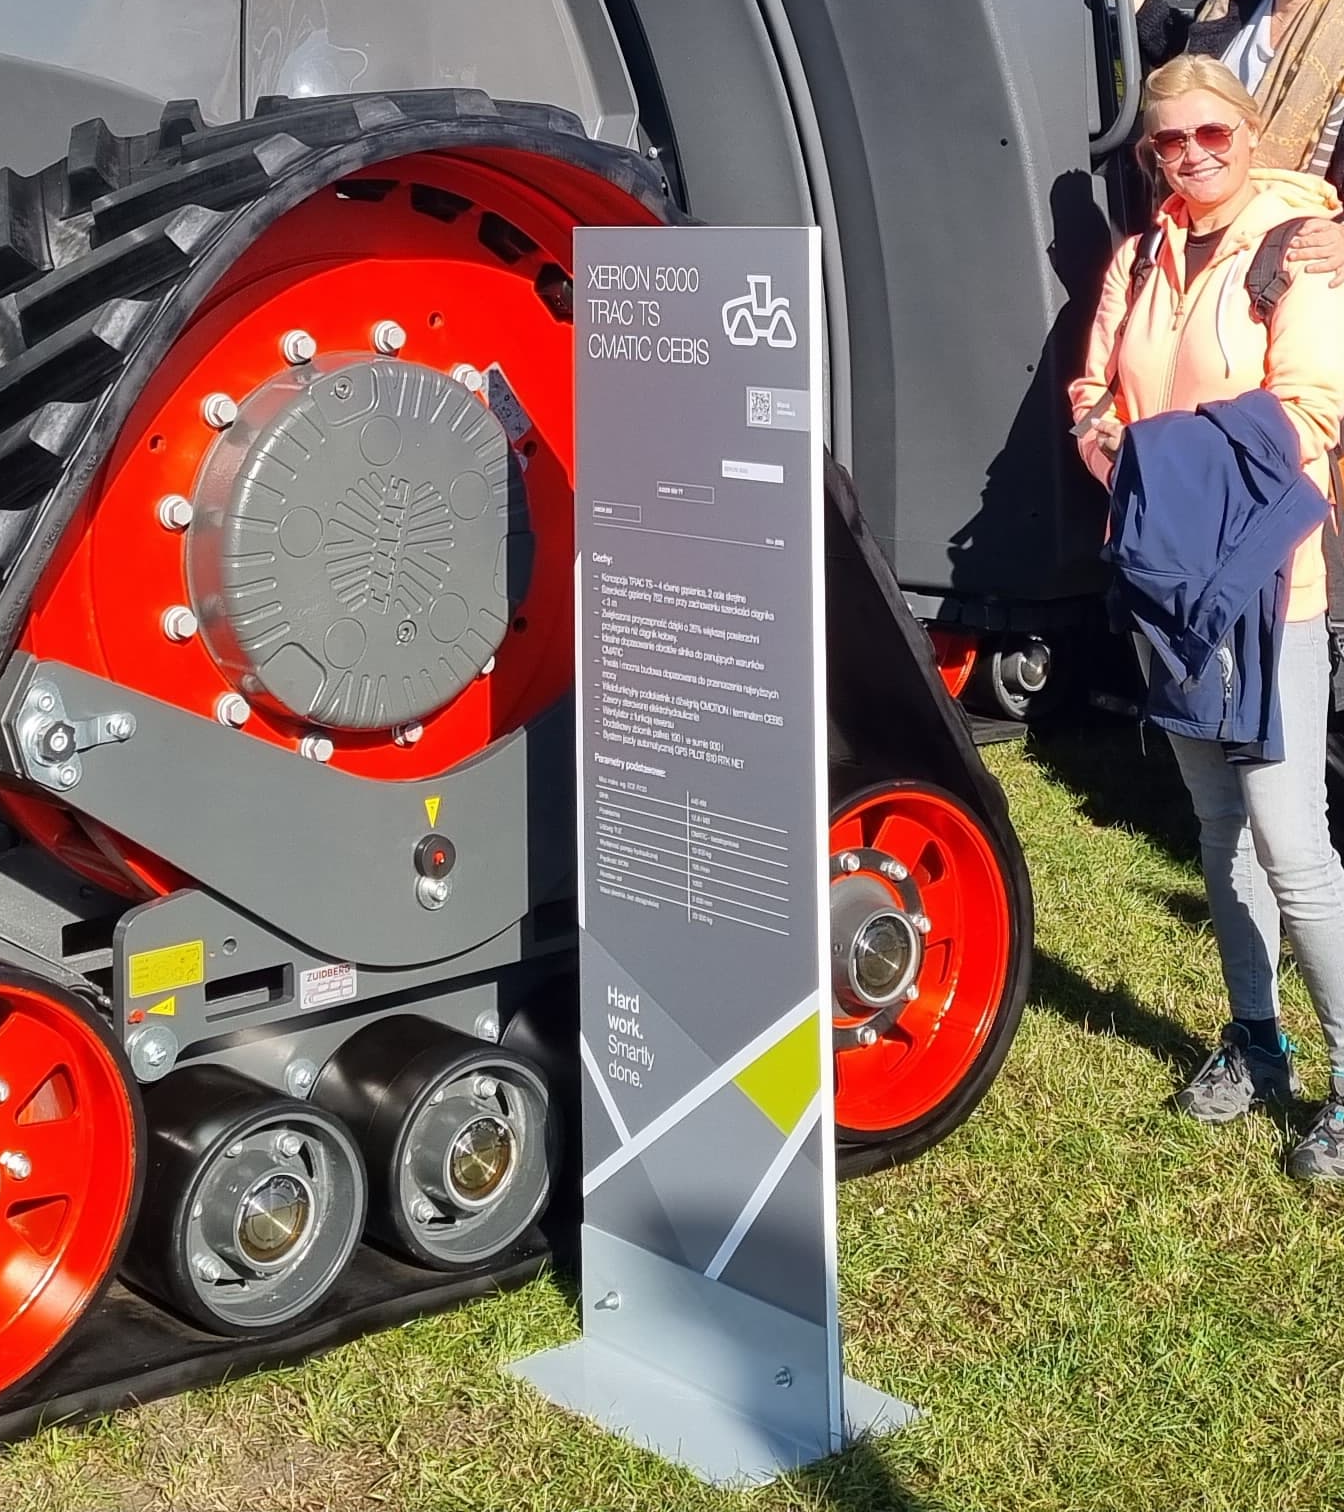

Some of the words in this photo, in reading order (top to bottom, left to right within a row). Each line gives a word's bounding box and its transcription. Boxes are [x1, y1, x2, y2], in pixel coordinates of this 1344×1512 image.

[587, 264, 651, 291] XERION
[655, 266, 699, 293] 5000
[587, 299, 634, 326] TRAC
[638, 300, 661, 327] TS
[588, 333, 652, 361] CMATIC
[656, 336, 710, 365] CEBIS
[306, 964, 351, 983] ZUIDBERG
[607, 986, 640, 1015] Hard
[607, 1014, 644, 1040] work.
[607, 1034, 655, 1071] Smartly
[608, 1062, 643, 1089] done.
